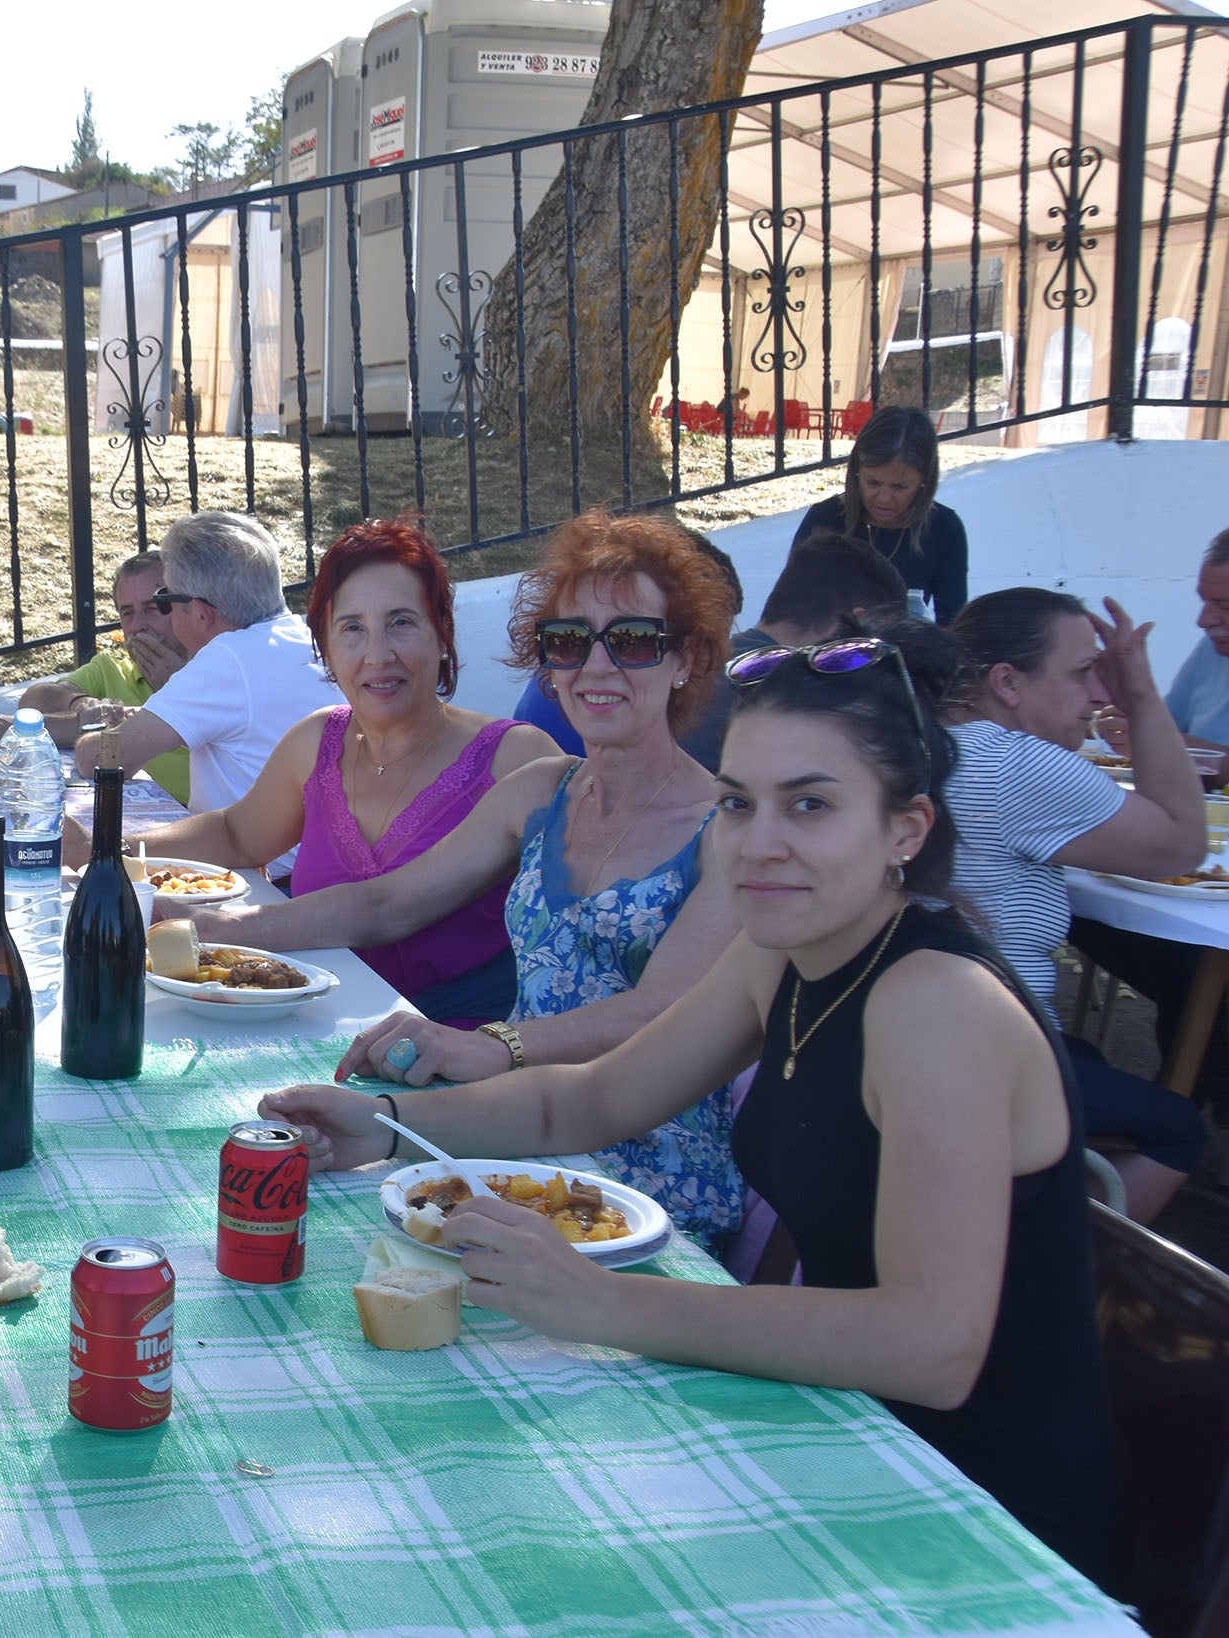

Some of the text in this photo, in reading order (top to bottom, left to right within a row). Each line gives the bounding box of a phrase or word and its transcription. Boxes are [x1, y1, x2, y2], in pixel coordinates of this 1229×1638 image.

[480, 53, 522, 62] ALQUILER
[525, 56, 548, 71] 923
[553, 57, 568, 72] 28
[571, 58, 586, 73] 87
[488, 63, 515, 71] VENTA
[229, 1220, 248, 1230] ZERO
